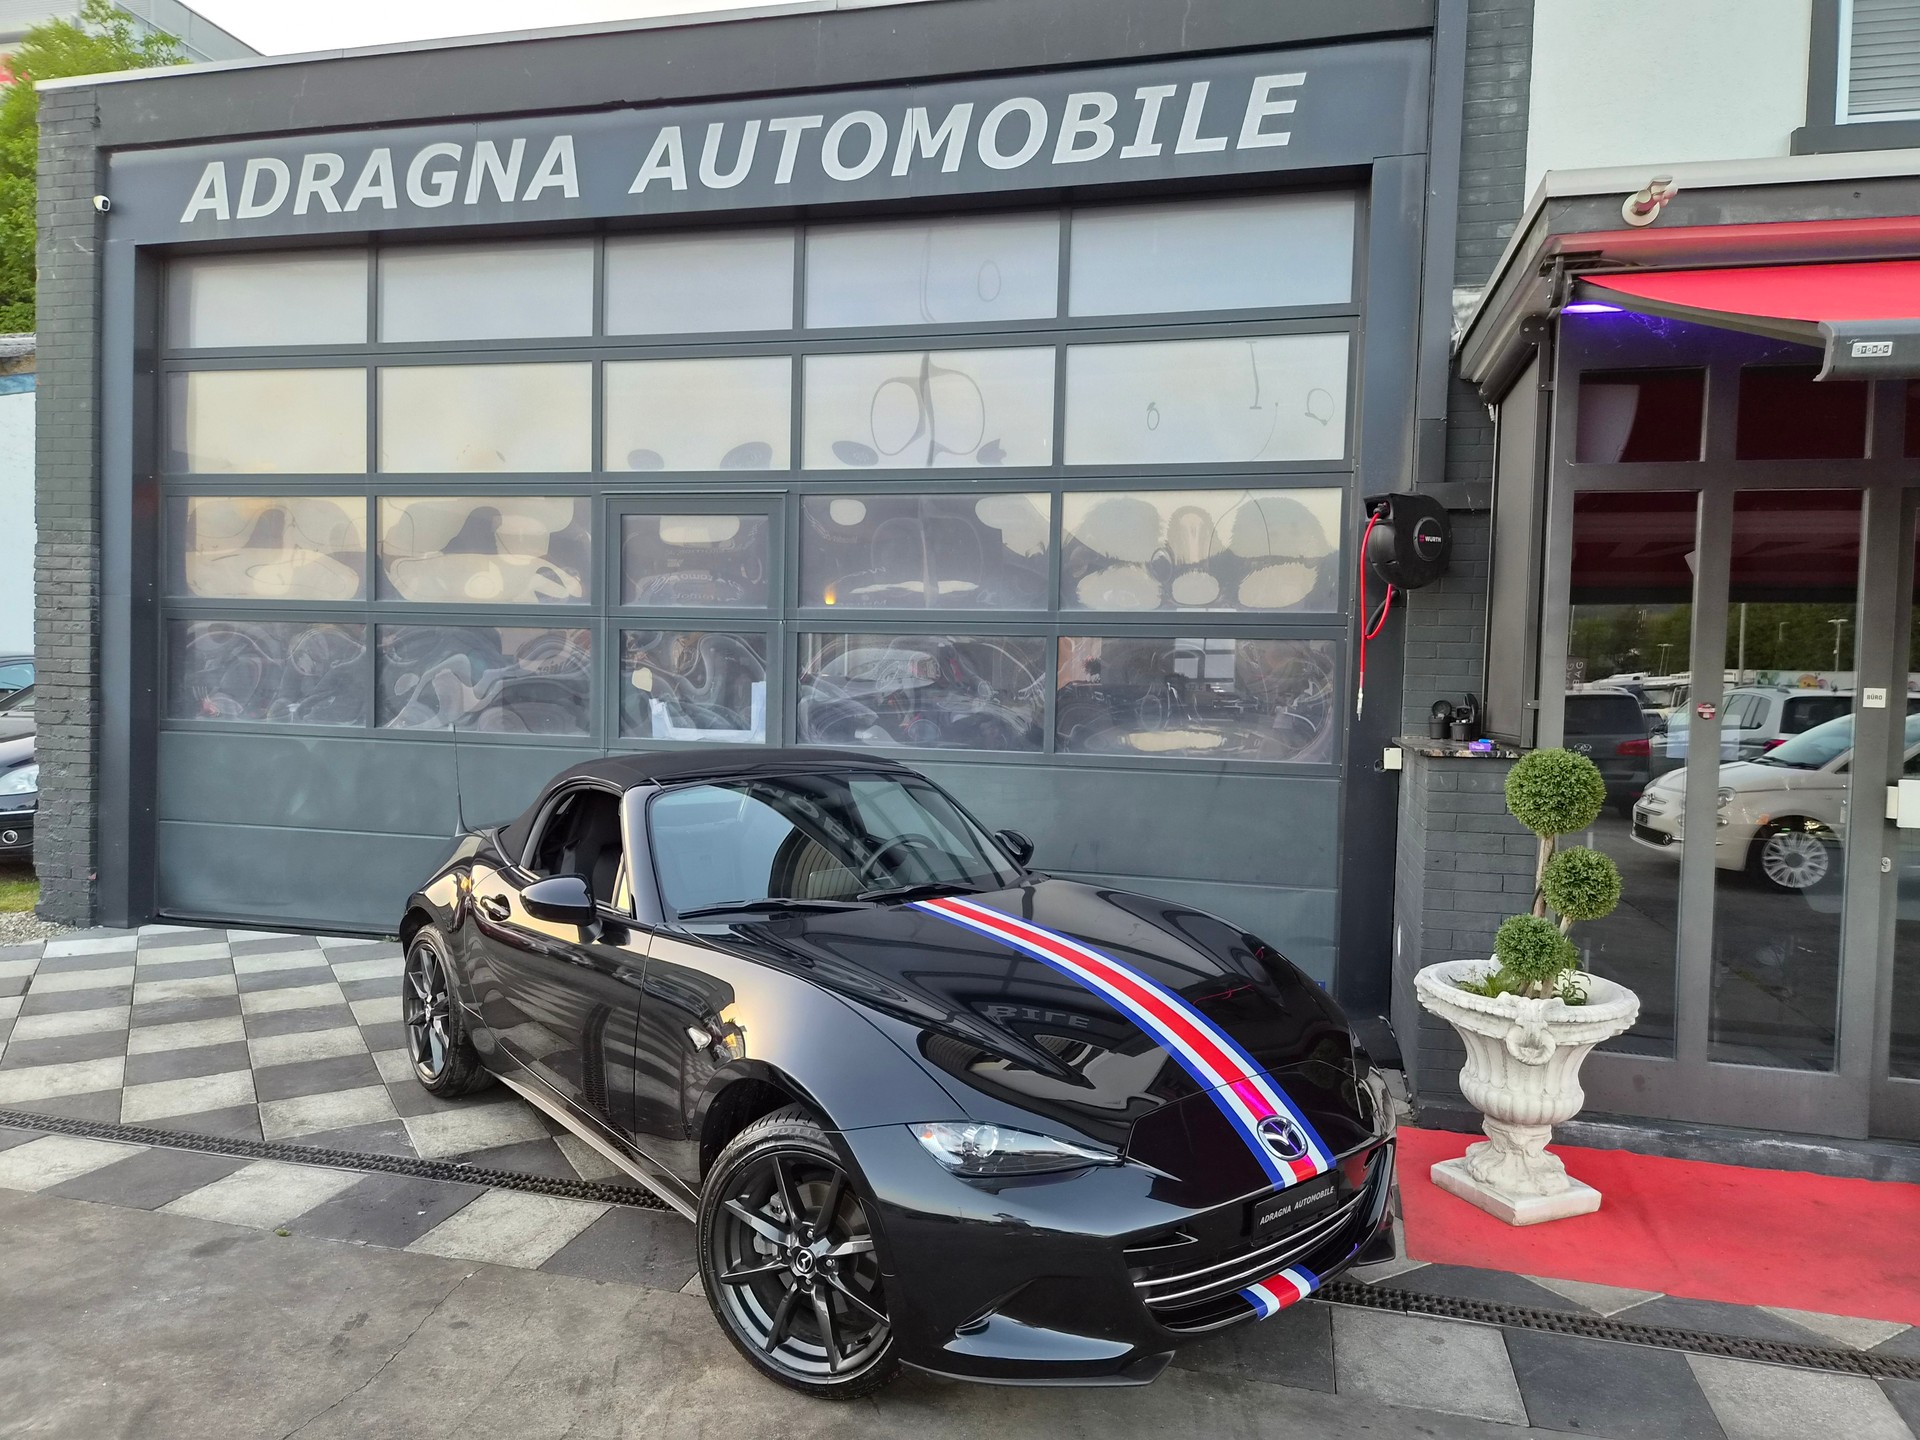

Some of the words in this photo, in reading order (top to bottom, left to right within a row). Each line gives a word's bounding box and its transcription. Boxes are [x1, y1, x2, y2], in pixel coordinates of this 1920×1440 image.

[180, 134, 580, 223] ADRAGNA
[628, 72, 1307, 194] AUTOMOBILE
[1260, 1205, 1292, 1225] ADRAGNA
[1294, 1186, 1335, 1210] AUTOMOBILE
